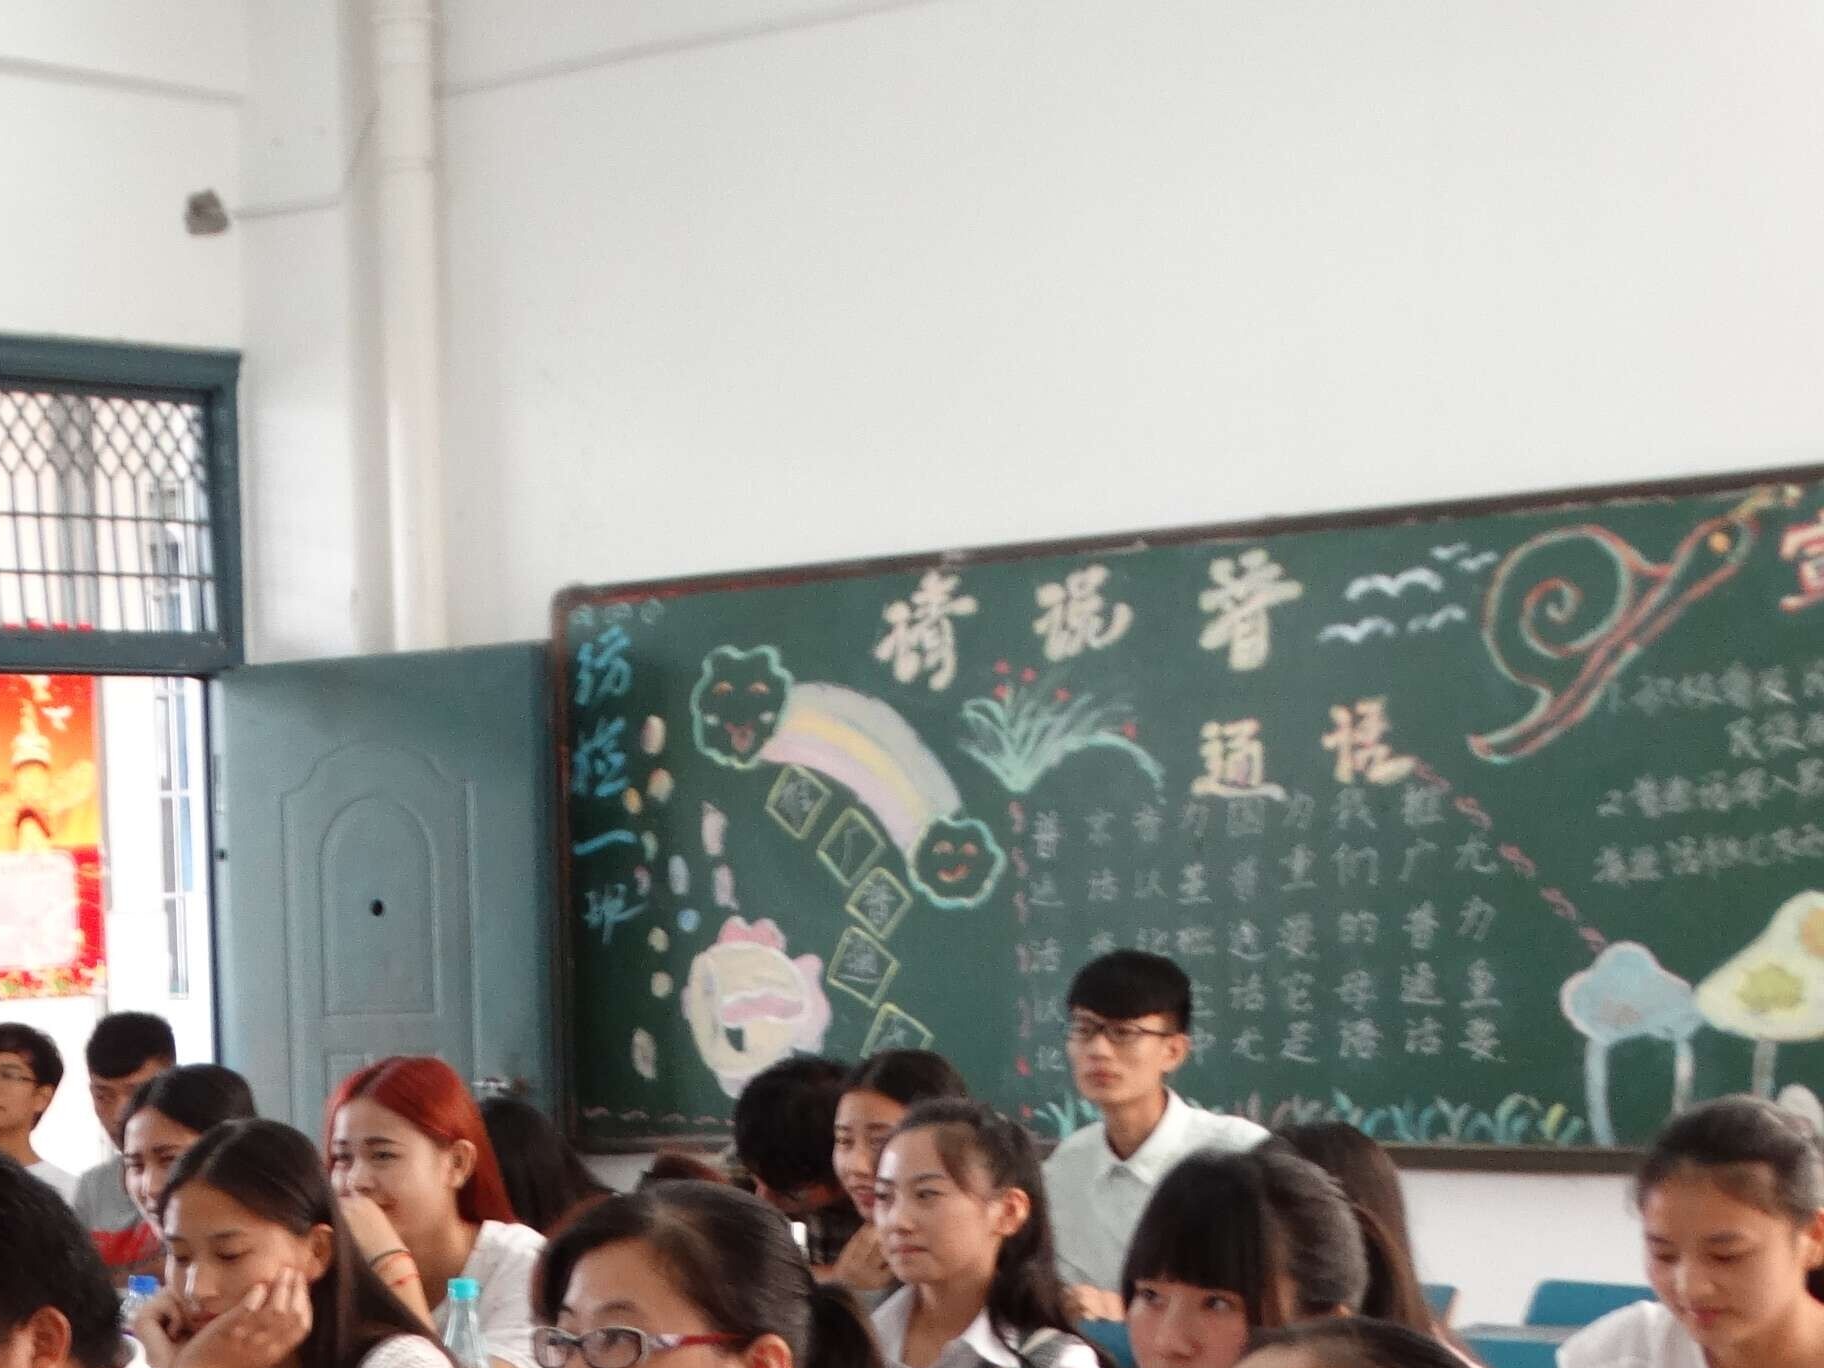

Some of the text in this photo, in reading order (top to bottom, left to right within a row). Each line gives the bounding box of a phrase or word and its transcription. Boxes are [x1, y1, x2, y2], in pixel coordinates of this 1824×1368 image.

[874, 546, 1304, 692] 请说普
[1190, 697, 1418, 802] 通话
